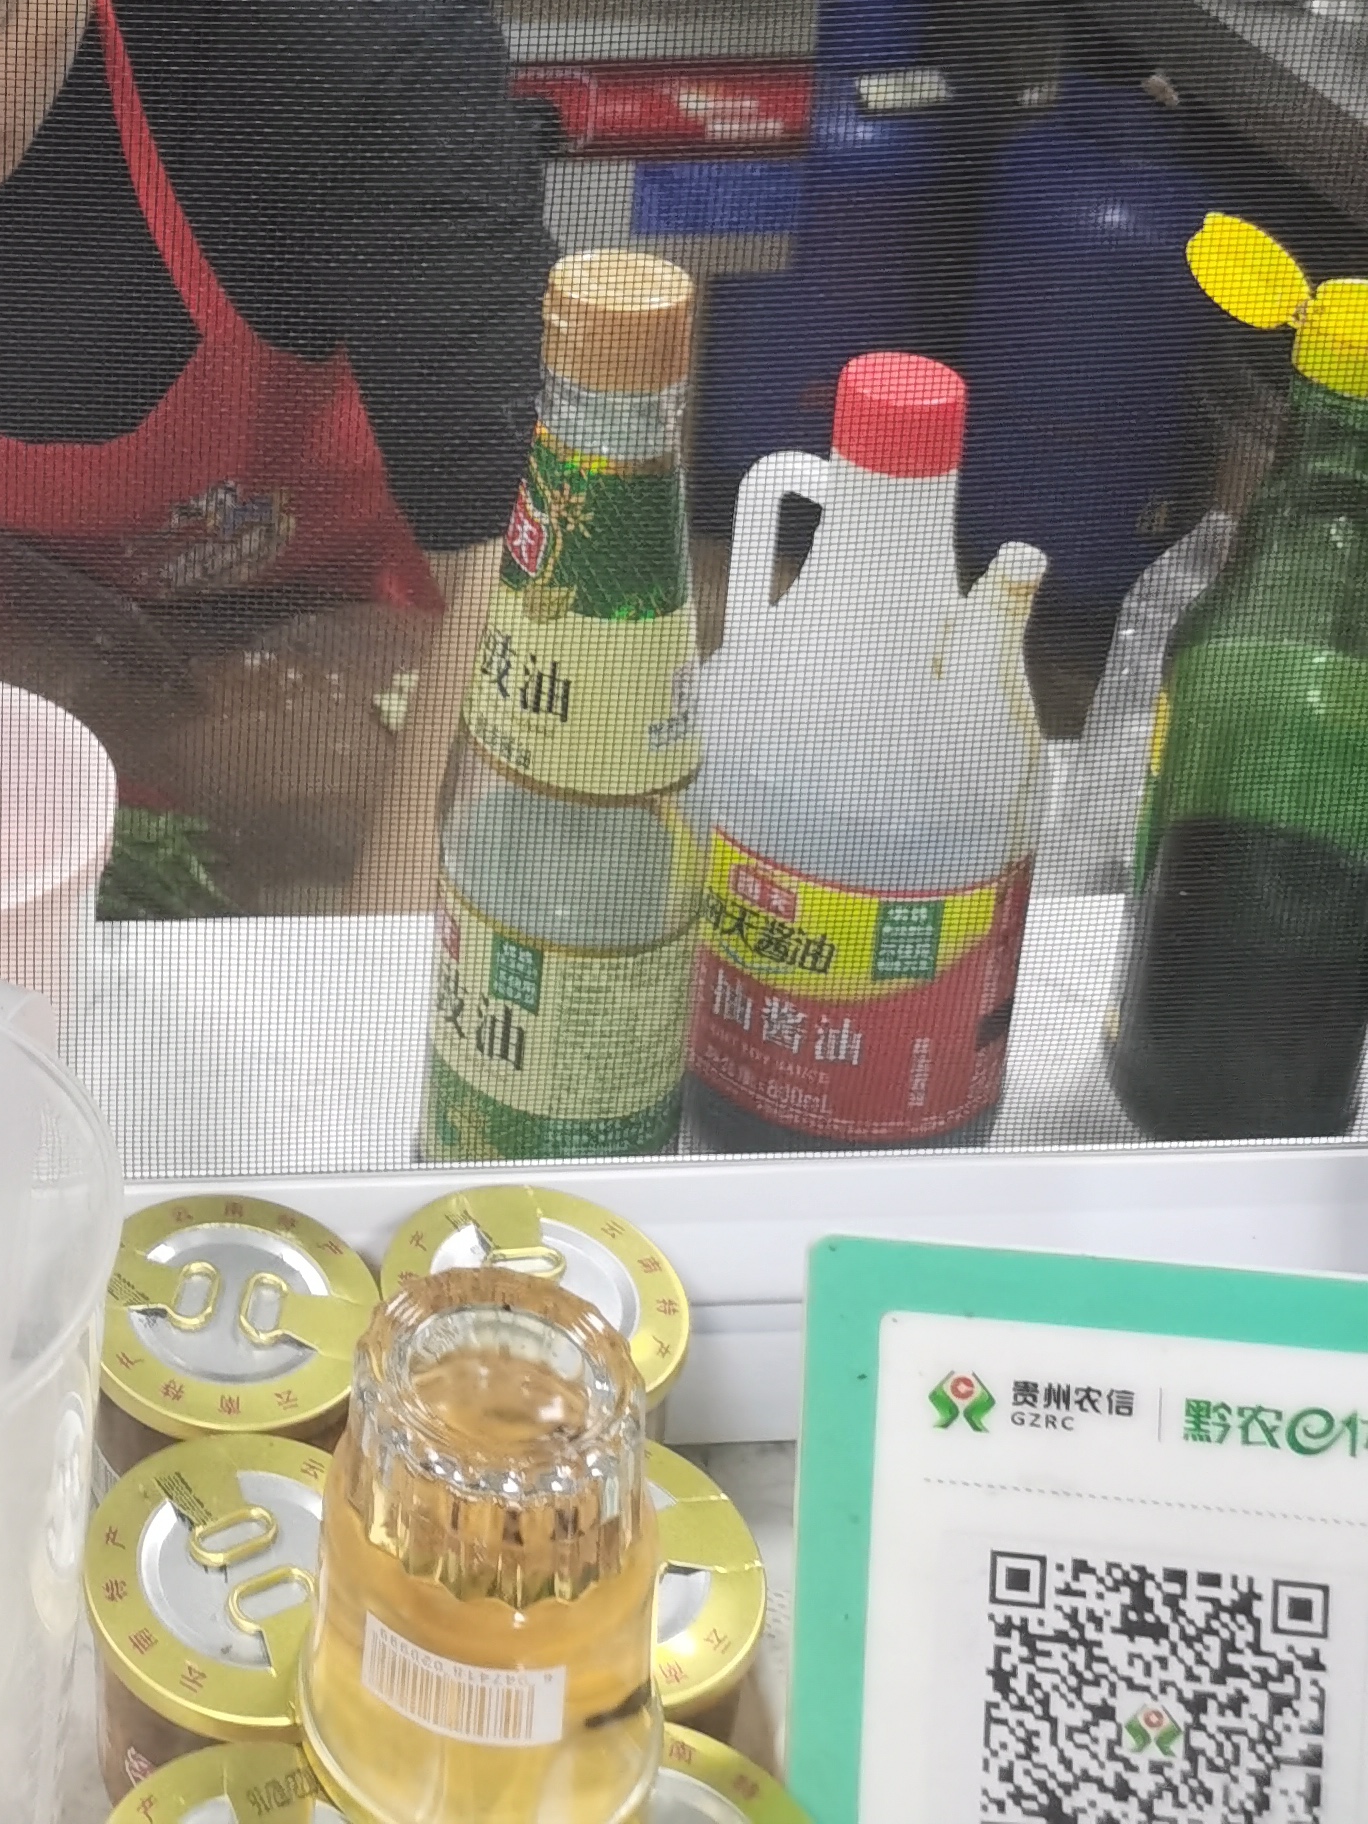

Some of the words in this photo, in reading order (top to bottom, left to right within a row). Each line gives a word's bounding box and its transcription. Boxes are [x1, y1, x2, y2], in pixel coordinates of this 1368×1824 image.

[1011, 1379, 1136, 1419] 贵州农信
[1009, 1409, 1075, 1433] GZRC
